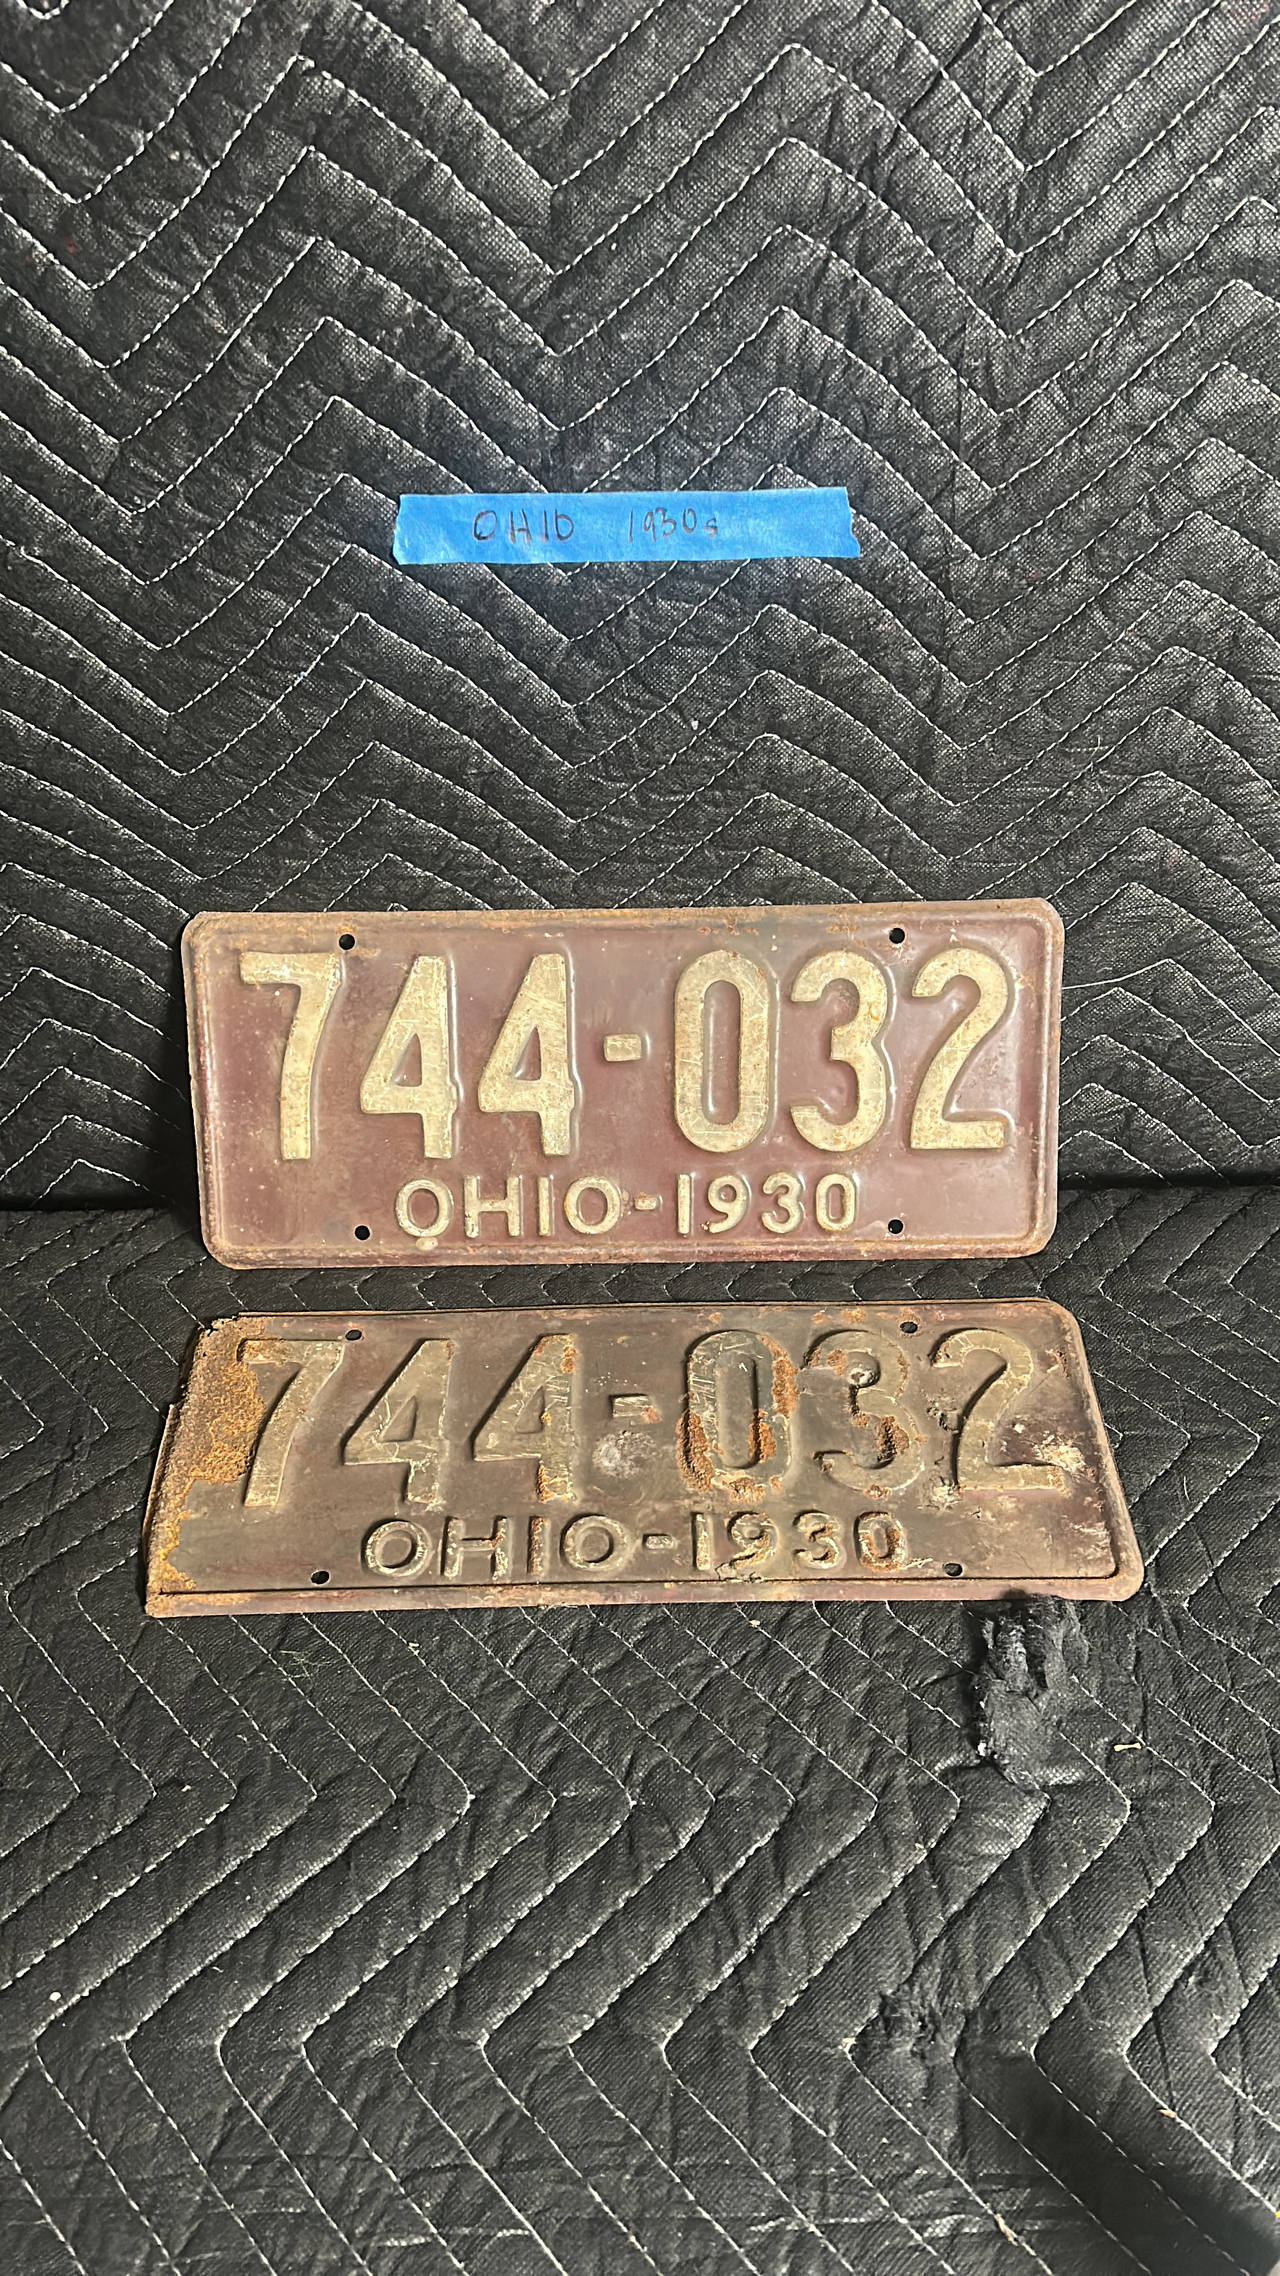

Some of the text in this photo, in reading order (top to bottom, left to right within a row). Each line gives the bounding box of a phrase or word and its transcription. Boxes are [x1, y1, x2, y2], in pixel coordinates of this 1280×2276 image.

[238, 948, 1012, 1161] 744-032
[394, 1171, 861, 1240] OHIO-1930
[238, 1327, 1067, 1509] 744-032
